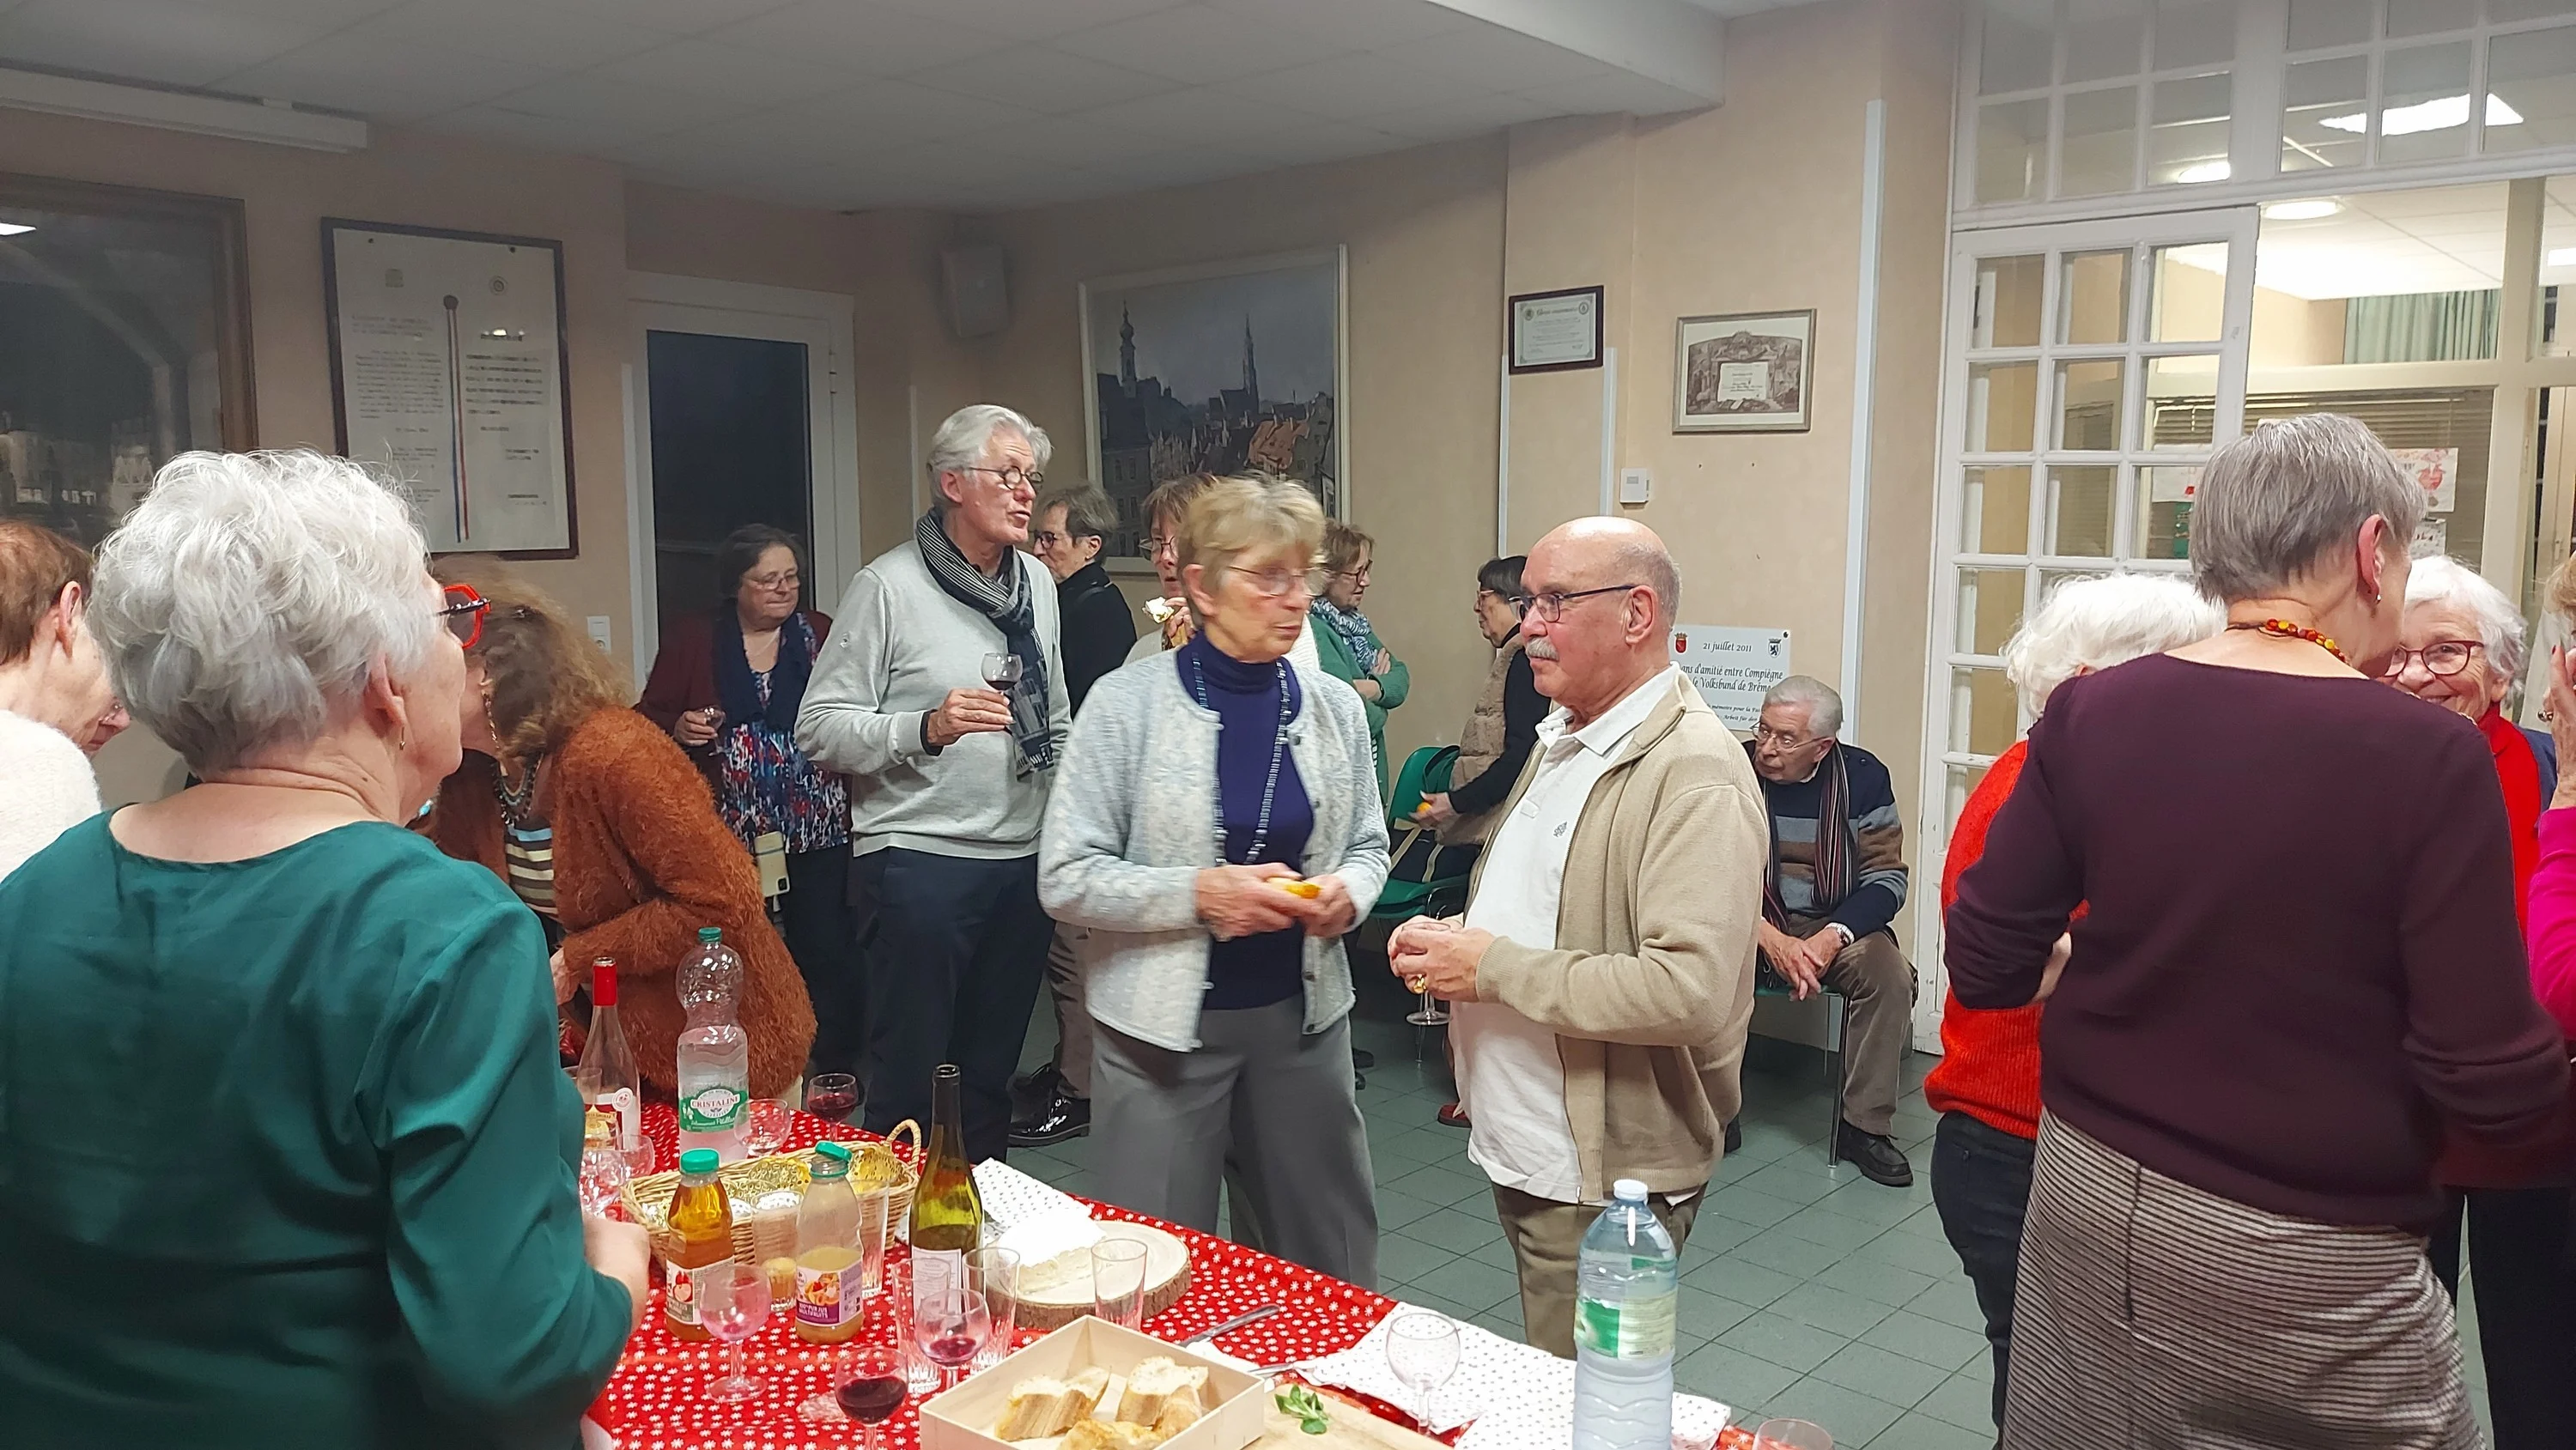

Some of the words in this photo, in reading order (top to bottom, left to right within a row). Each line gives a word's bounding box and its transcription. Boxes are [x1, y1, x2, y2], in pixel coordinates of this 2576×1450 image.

[1710, 640, 1735, 653] juillet
[1681, 665, 1693, 674] ans
[1694, 663, 1722, 676] d'amitié
[1724, 667, 1743, 677] entre
[1700, 676, 1736, 690] Volksbund
[1737, 680, 1747, 690] de
